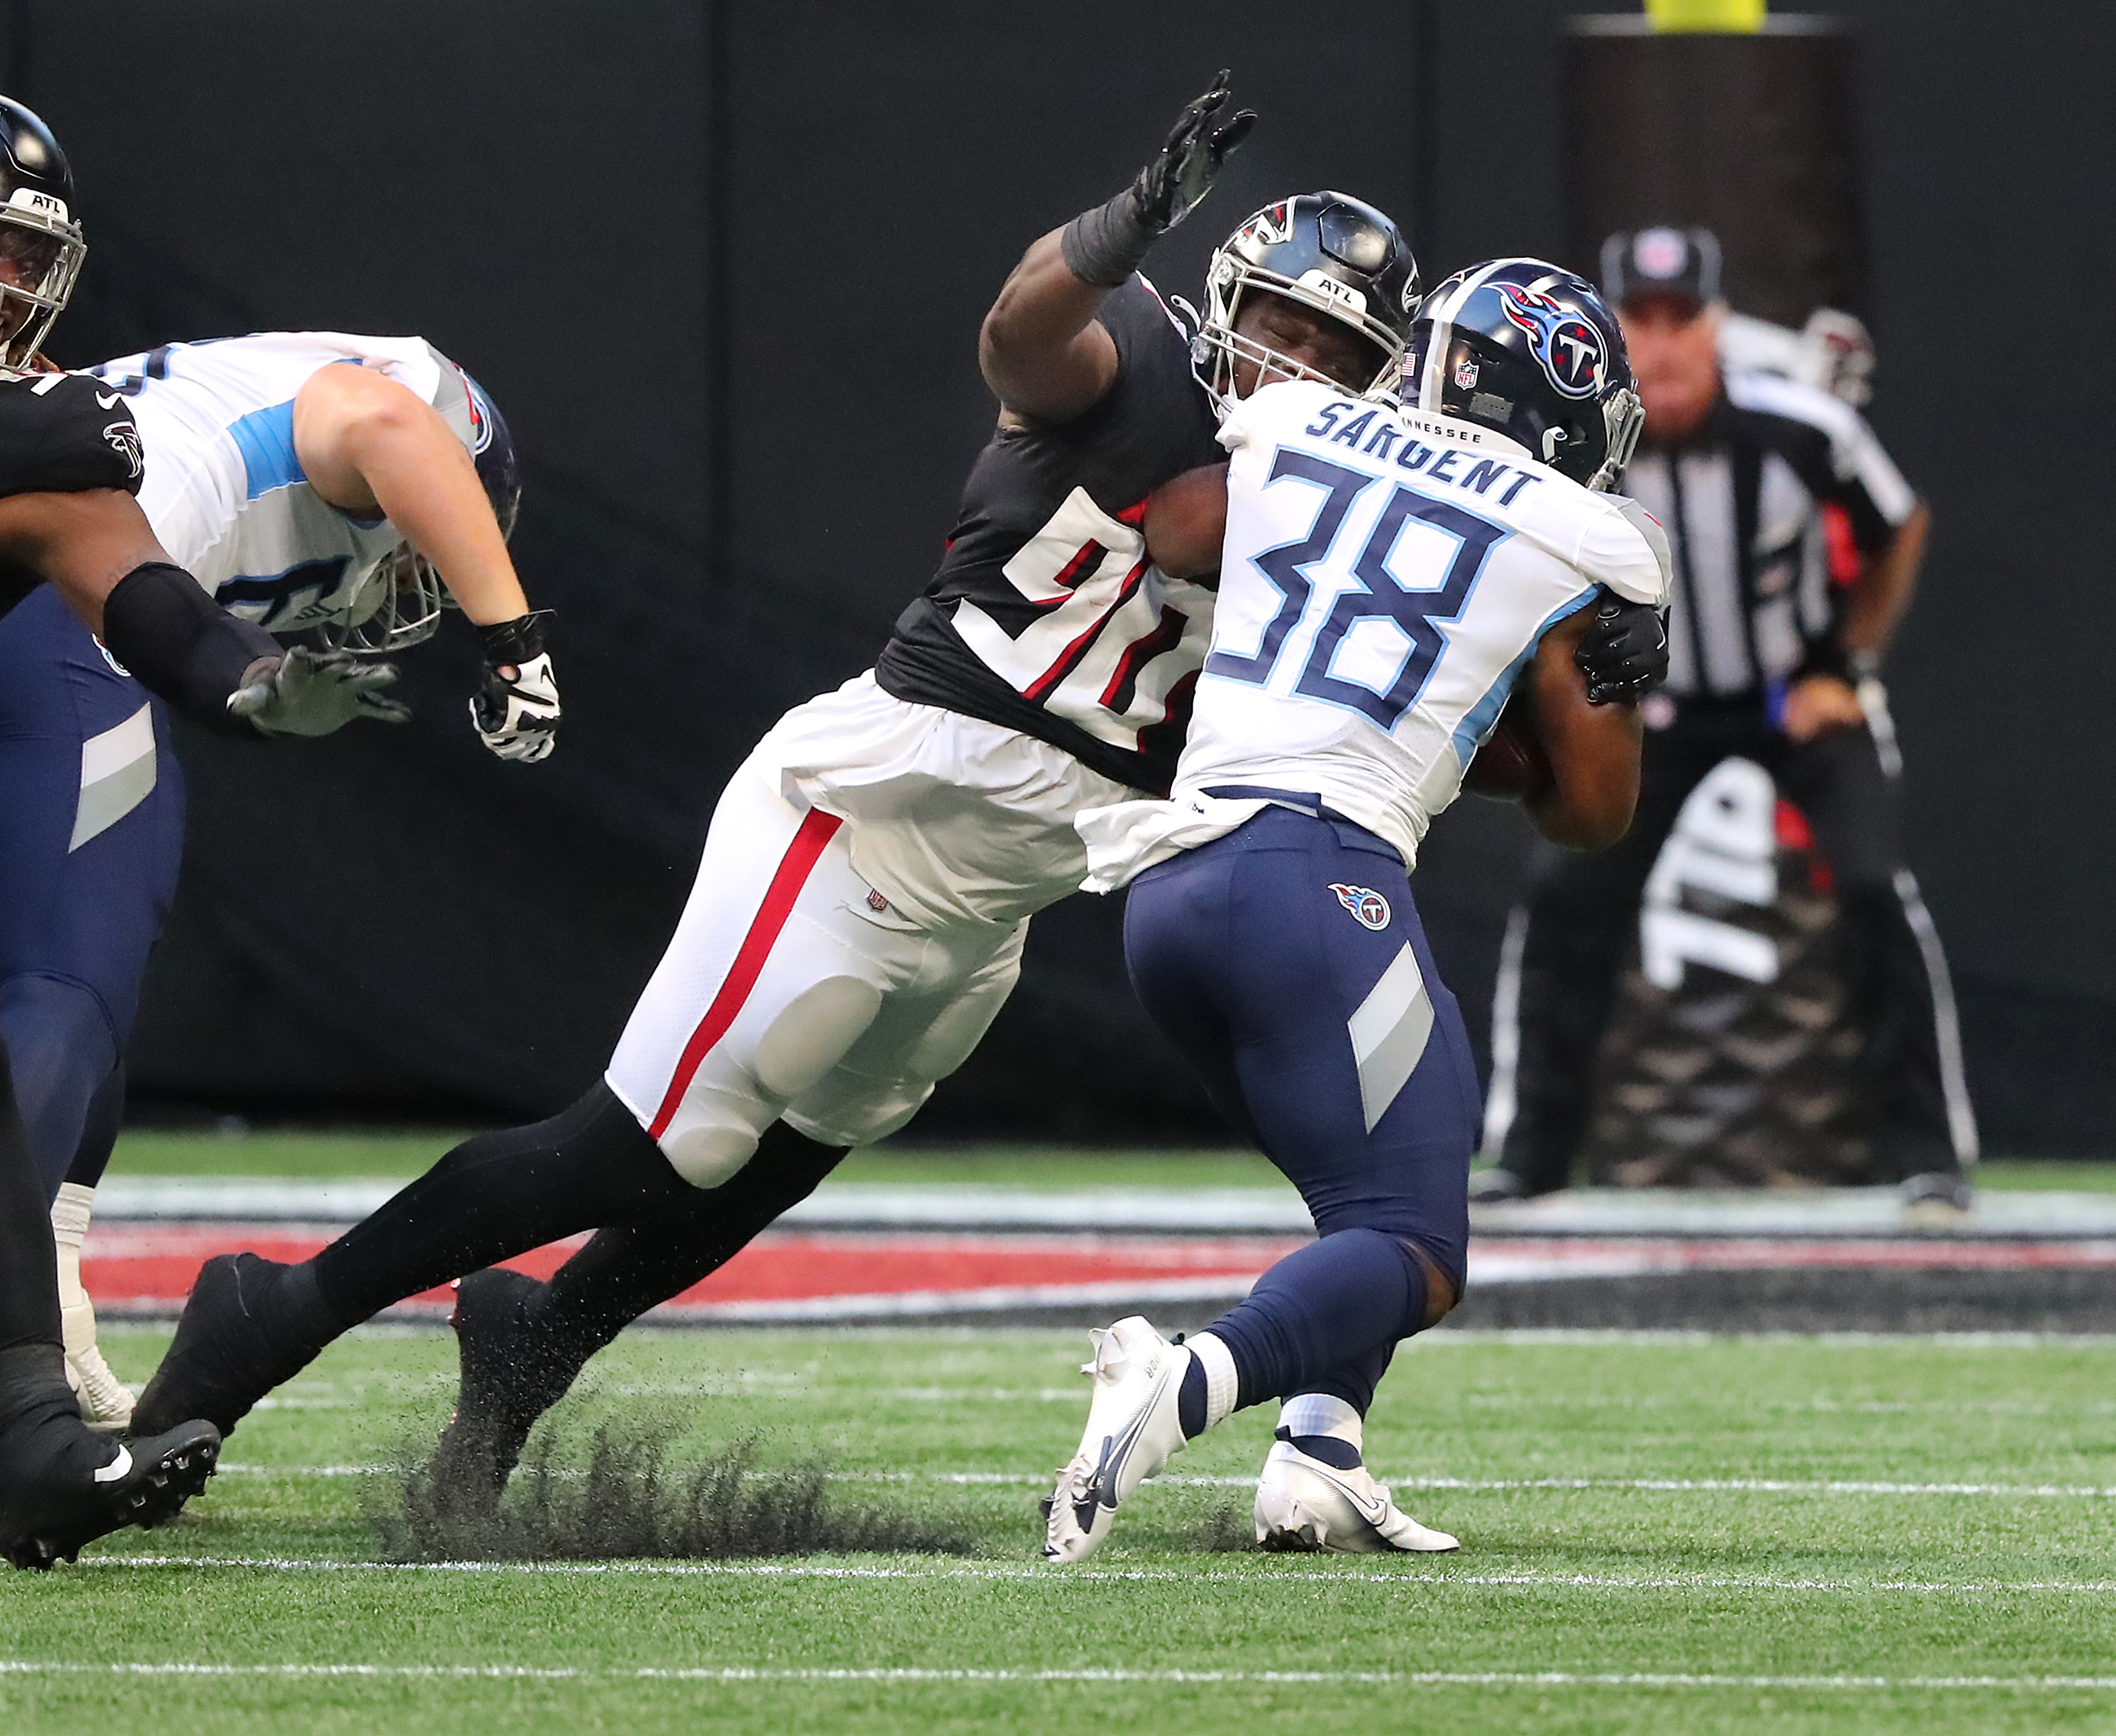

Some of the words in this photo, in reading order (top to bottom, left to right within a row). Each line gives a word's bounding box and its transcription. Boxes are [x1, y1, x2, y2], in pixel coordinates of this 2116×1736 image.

[32, 195, 60, 213] ATL
[1318, 278, 1352, 304] ATL
[1458, 373, 1475, 385] NFL
[1304, 401, 1546, 509] SARGENT
[1202, 444, 1516, 737] 38
